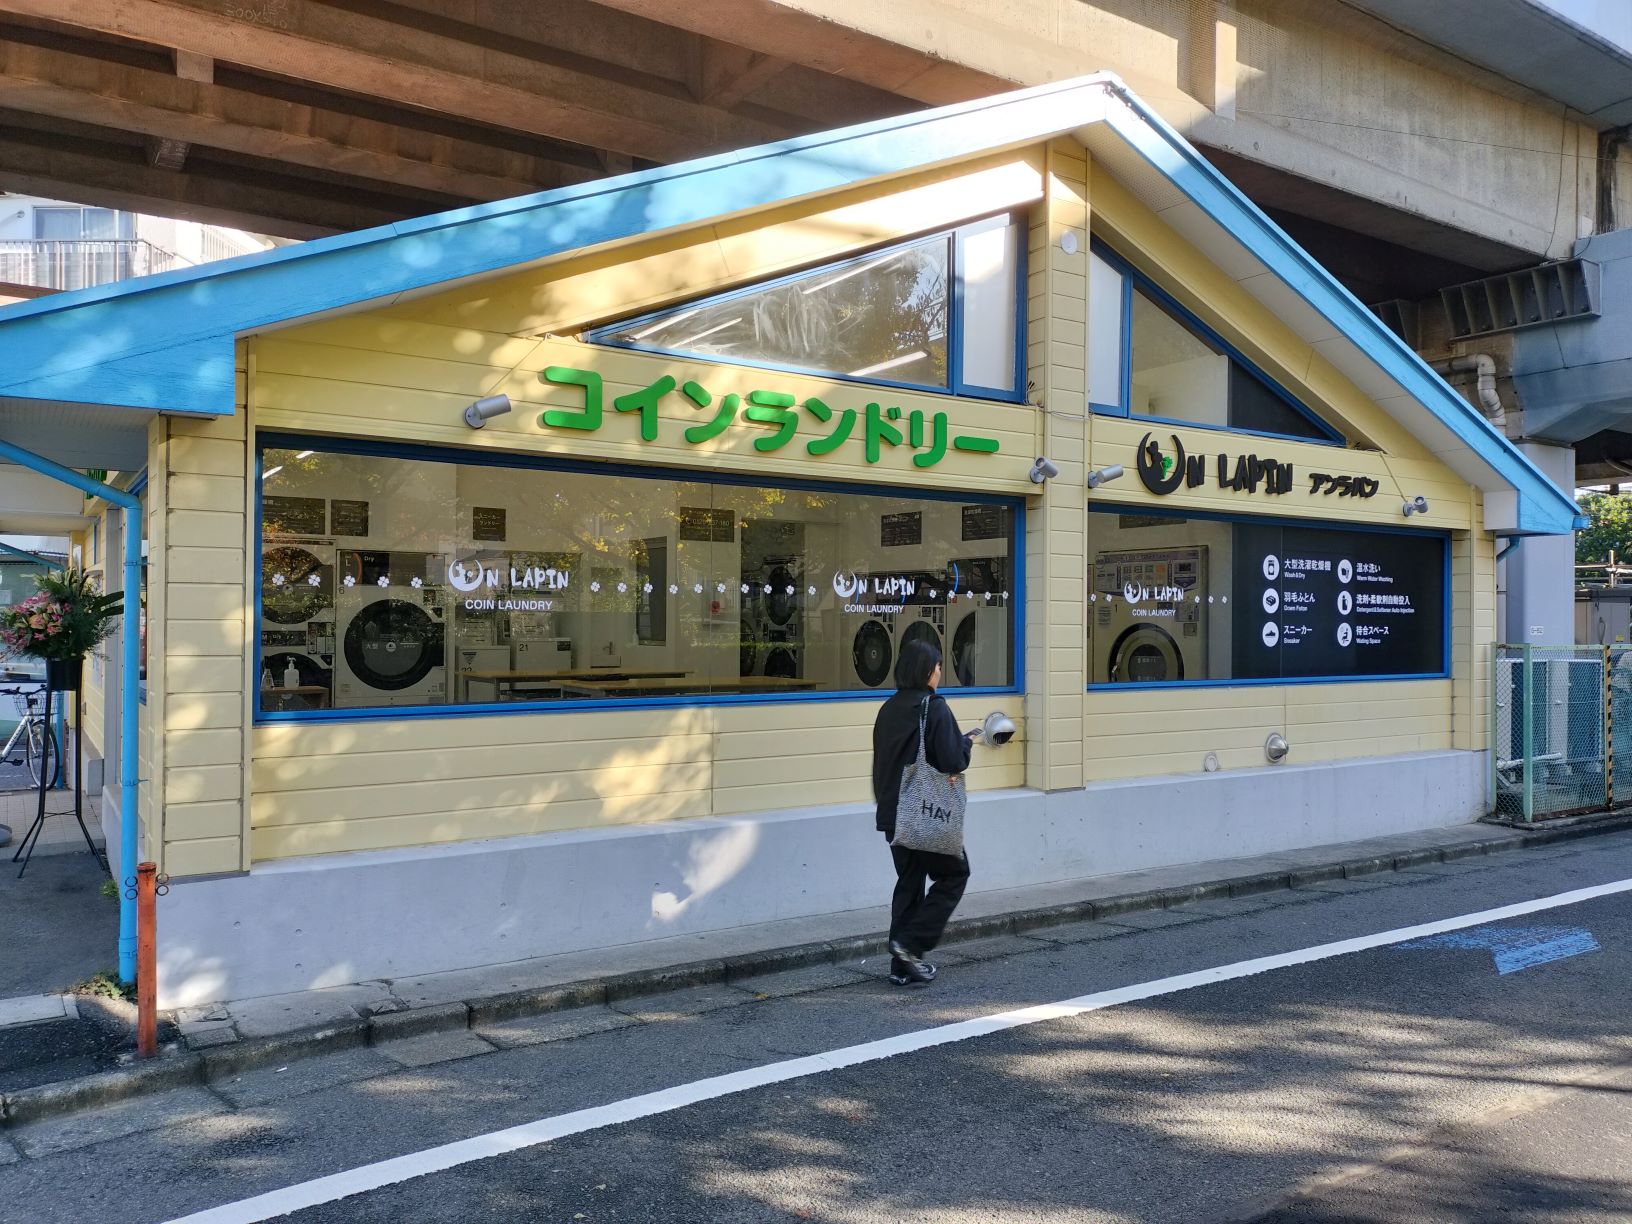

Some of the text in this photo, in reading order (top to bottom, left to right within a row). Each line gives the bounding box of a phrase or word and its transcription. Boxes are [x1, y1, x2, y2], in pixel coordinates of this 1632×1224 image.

[542, 365, 1000, 468] コインランドリー
[1218, 454, 1294, 496] LAPIN
[1309, 472, 1379, 499] アンラパン
[1356, 563, 1381, 573] 温水洗い
[510, 567, 570, 589] LAPIN
[875, 577, 915, 596] LAPIN
[1154, 586, 1184, 602] LAPIN
[1284, 592, 1315, 602] 羽毛ふとん
[465, 599, 553, 611] COIN LAUNDRY
[844, 604, 904, 614] COIN LAUNDRY
[1132, 609, 1176, 617] COIN LAUNDRY
[1284, 625, 1313, 635] スニーカー
[1356, 625, 1389, 636] 待合スペース
[921, 800, 952, 823] HAY
